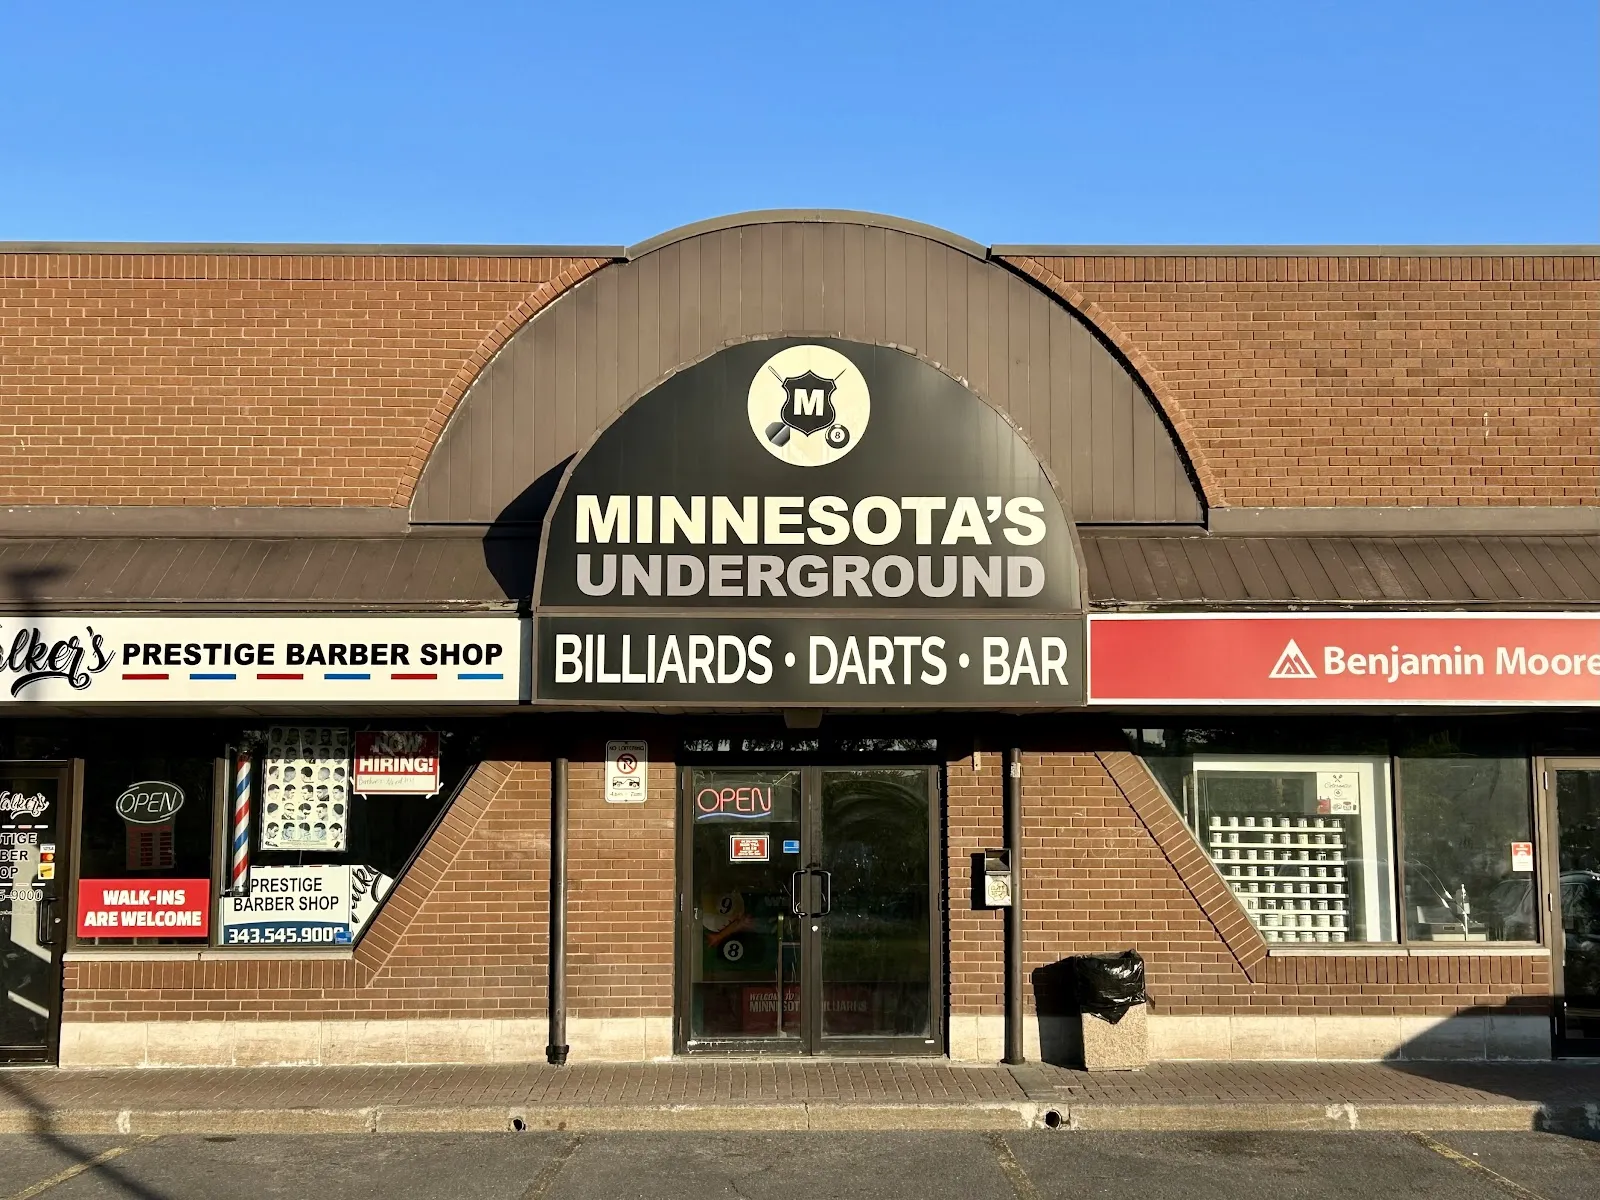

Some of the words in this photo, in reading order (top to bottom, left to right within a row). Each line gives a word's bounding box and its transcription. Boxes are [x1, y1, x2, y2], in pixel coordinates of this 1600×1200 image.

[793, 388, 825, 416] M
[834, 431, 841, 440] 8
[575, 494, 1047, 545] MINNESOTA'S
[576, 553, 1045, 598] UNDERGROUND
[122, 643, 275, 666] PRESTIGE
[286, 643, 410, 666] BARBER
[420, 643, 503, 666] SHOP
[554, 633, 773, 686] BILLIARDS
[808, 635, 947, 686] DARTS
[982, 636, 1068, 686] BAR
[1324, 645, 1485, 683] Benjamin
[1495, 646, 1600, 676] Moore
[359, 755, 434, 773] HIRING!
[119, 791, 178, 813] OPEN
[697, 787, 771, 812] OPEN
[251, 877, 323, 893] PRESTIGE
[103, 889, 186, 906] WALK-INS
[233, 896, 295, 912] BARBER
[299, 896, 340, 911] SHOP
[719, 897, 733, 914] 9
[84, 911, 118, 927] ARE
[121, 911, 202, 927] WELCOME
[728, 943, 740, 957] 8
